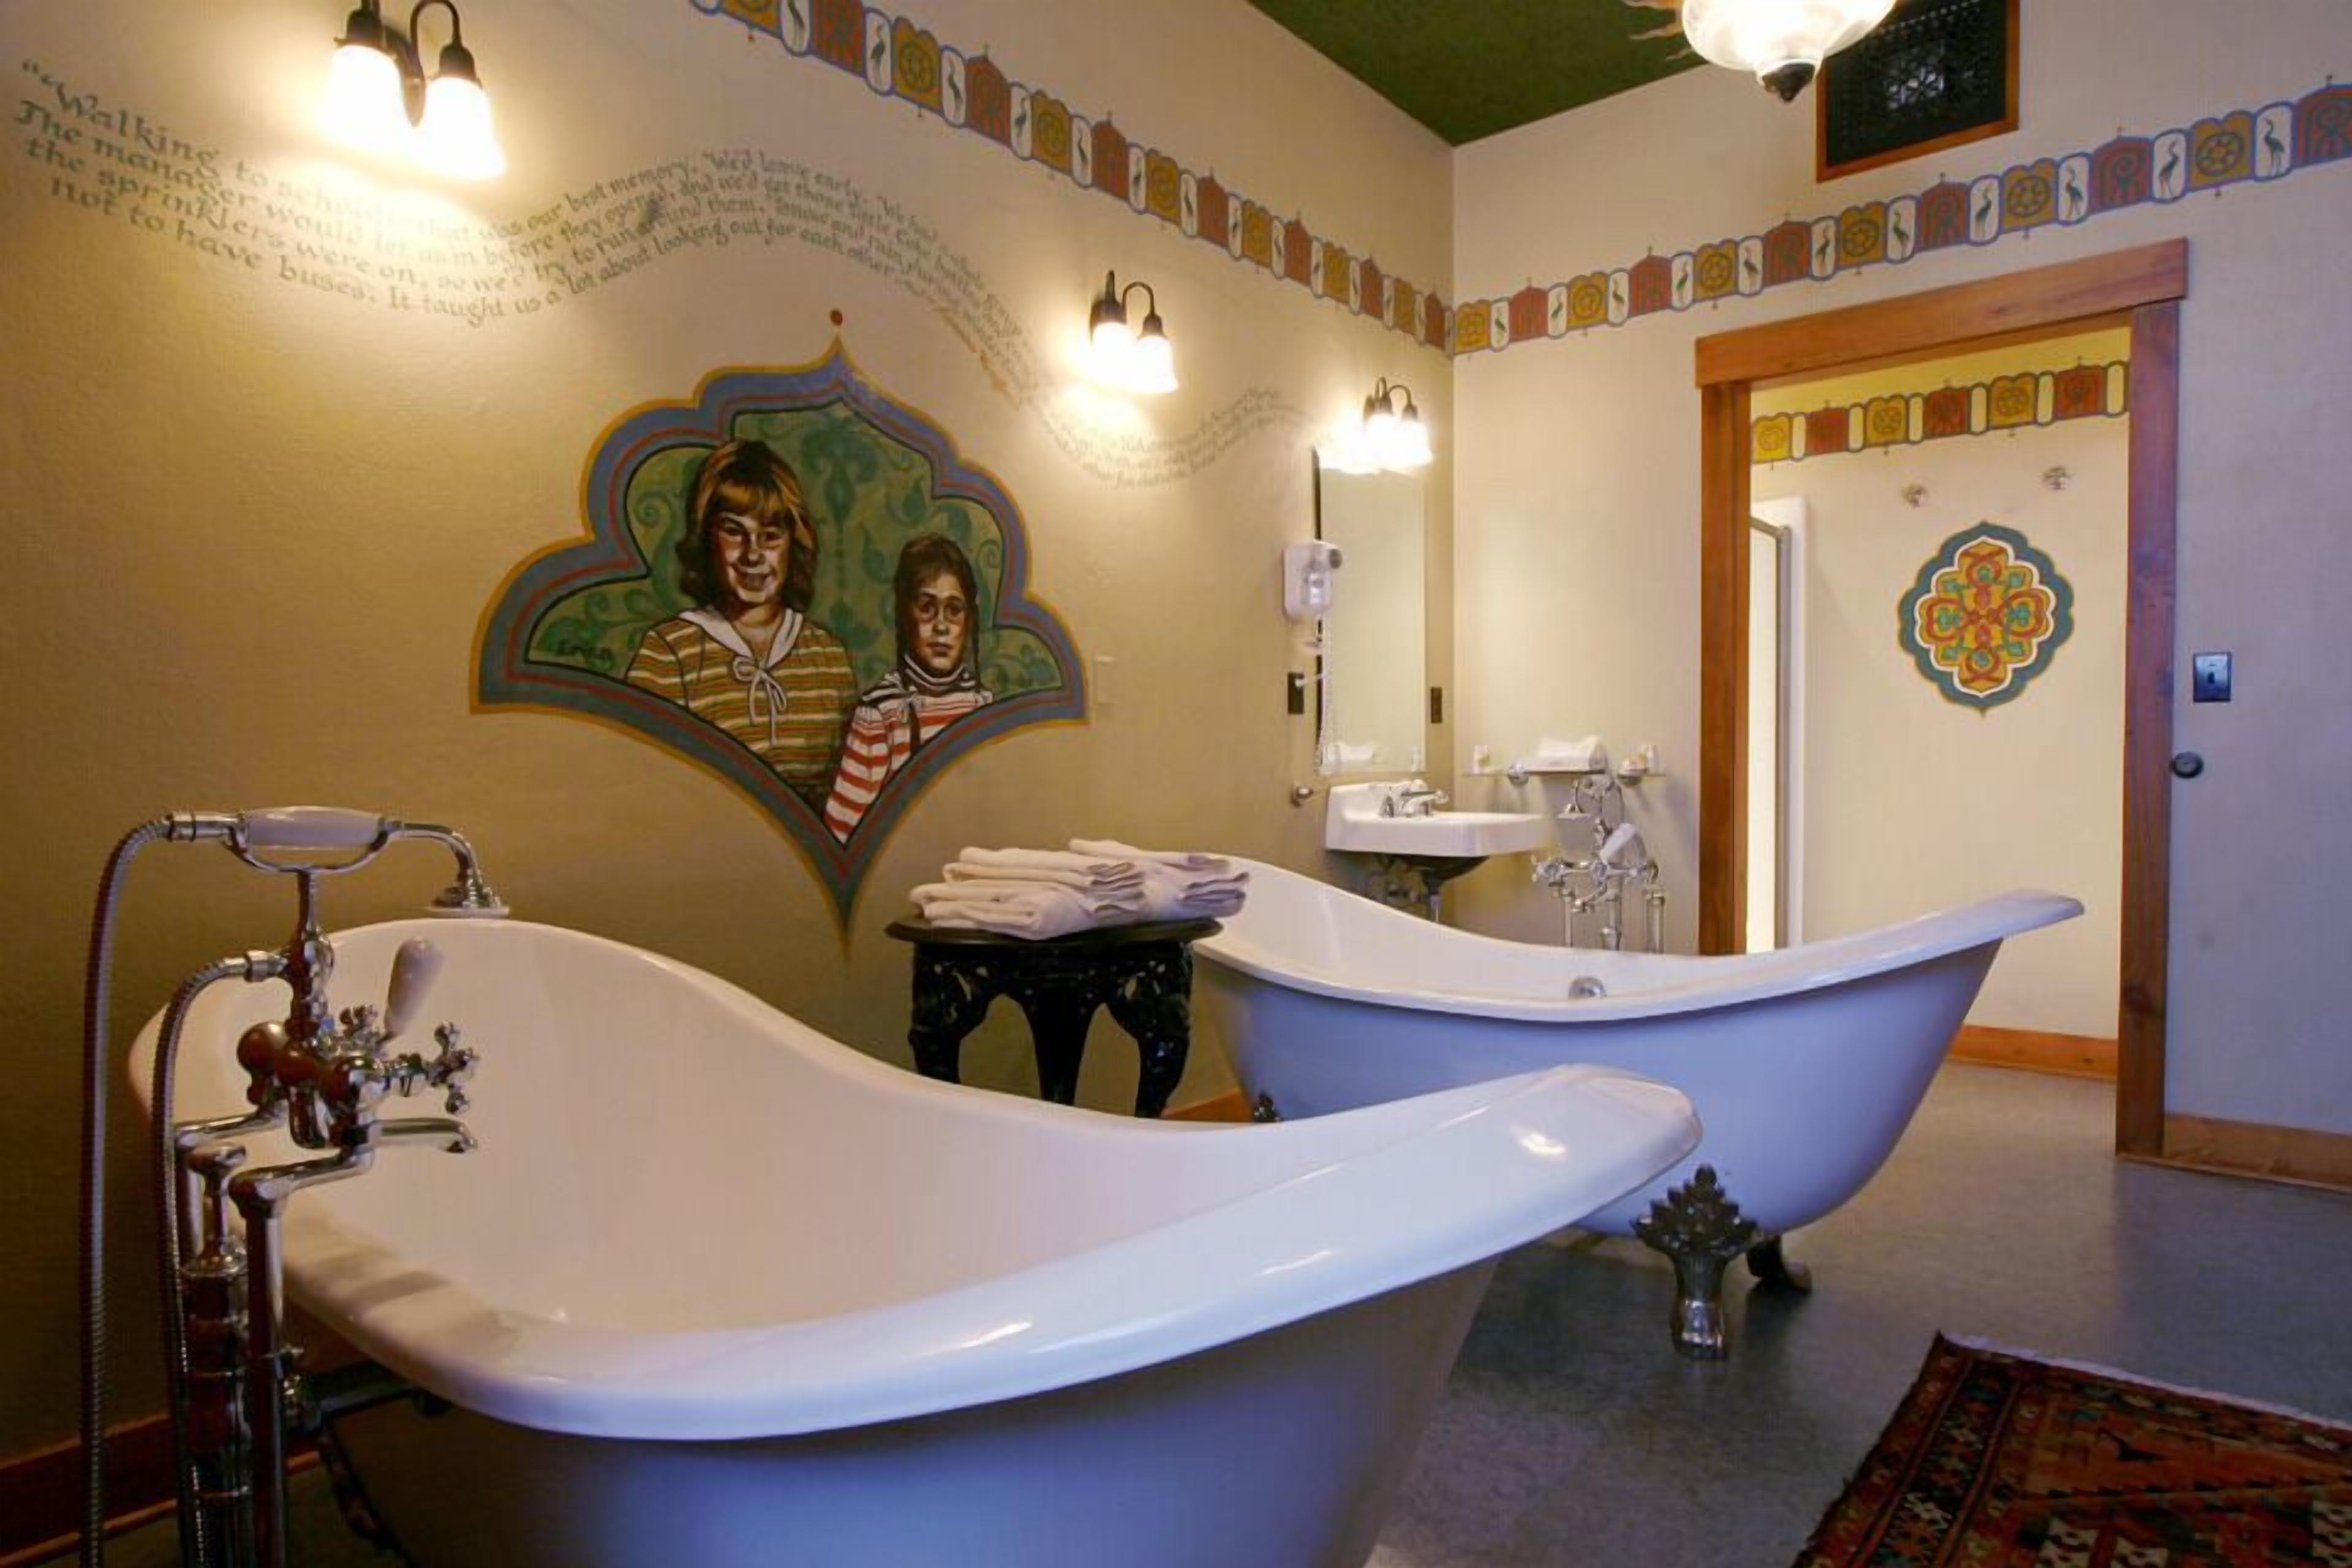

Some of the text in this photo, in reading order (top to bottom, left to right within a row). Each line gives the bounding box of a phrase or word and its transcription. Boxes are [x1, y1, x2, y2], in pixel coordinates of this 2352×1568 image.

[15, 98, 83, 144] The
[94, 137, 258, 209] manager
[266, 202, 363, 247] would
[28, 137, 84, 172] the
[98, 169, 285, 248] sprinklers
[296, 243, 370, 274] were
[572, 246, 595, 266] to
[236, 159, 268, 186] to
[526, 202, 562, 232] our
[564, 181, 607, 213] best
[51, 183, 118, 217] not
[129, 205, 164, 233] to
[176, 219, 263, 270] have
[388, 284, 409, 310] It
[421, 296, 505, 328] taught
[513, 298, 541, 314] us
[545, 290, 562, 306] a
[565, 272, 597, 295] lot
[600, 246, 652, 283] about
[730, 221, 764, 235] out
